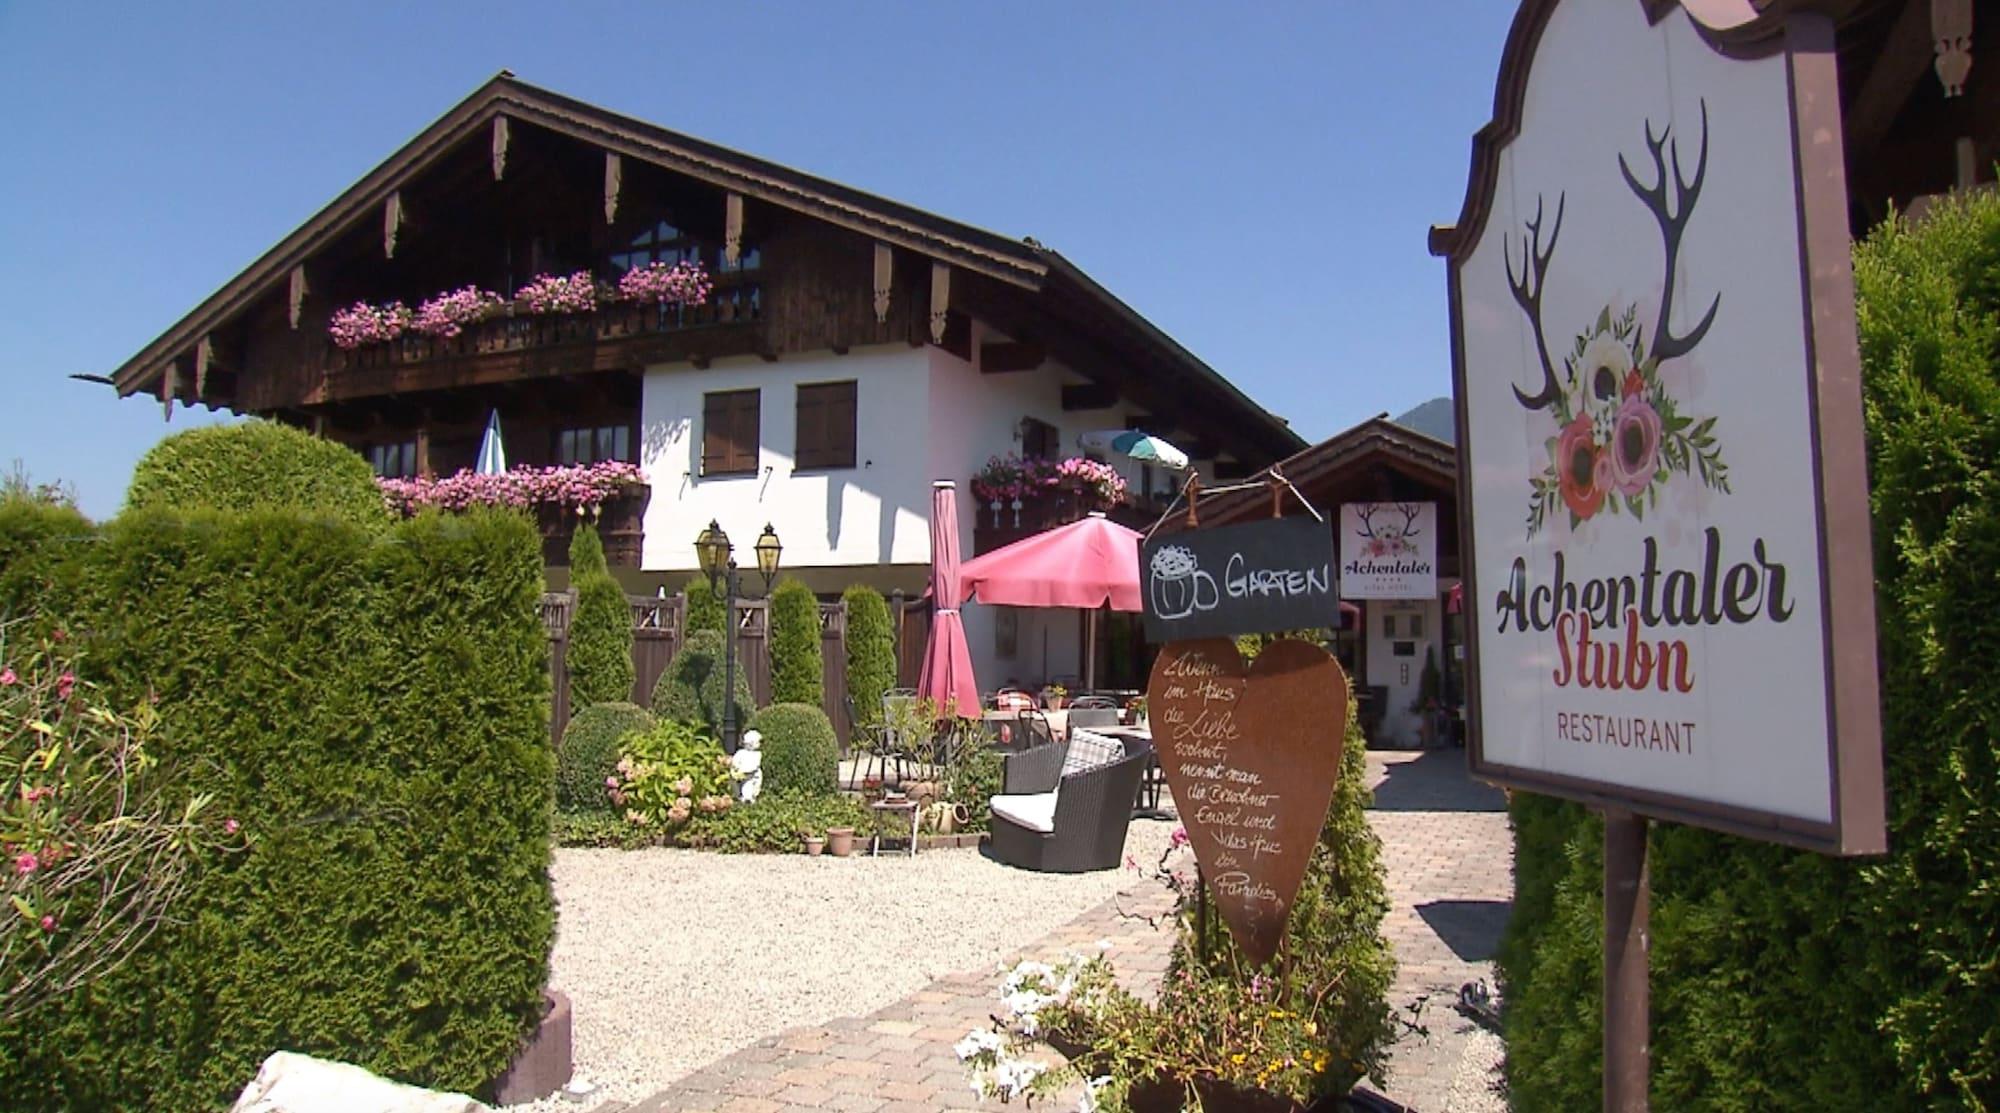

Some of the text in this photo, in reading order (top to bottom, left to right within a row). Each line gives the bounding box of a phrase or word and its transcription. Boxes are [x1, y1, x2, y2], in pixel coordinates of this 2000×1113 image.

[1345, 560, 1431, 575] Achentaler
[1497, 526, 1795, 633] Achentaler
[1553, 608, 1695, 693] Stubn
[1163, 678, 1235, 707] im Haus
[1164, 706, 1240, 740] die Liebe
[1557, 712, 1696, 755] RESTAURANT
[1243, 814, 1276, 830] und
